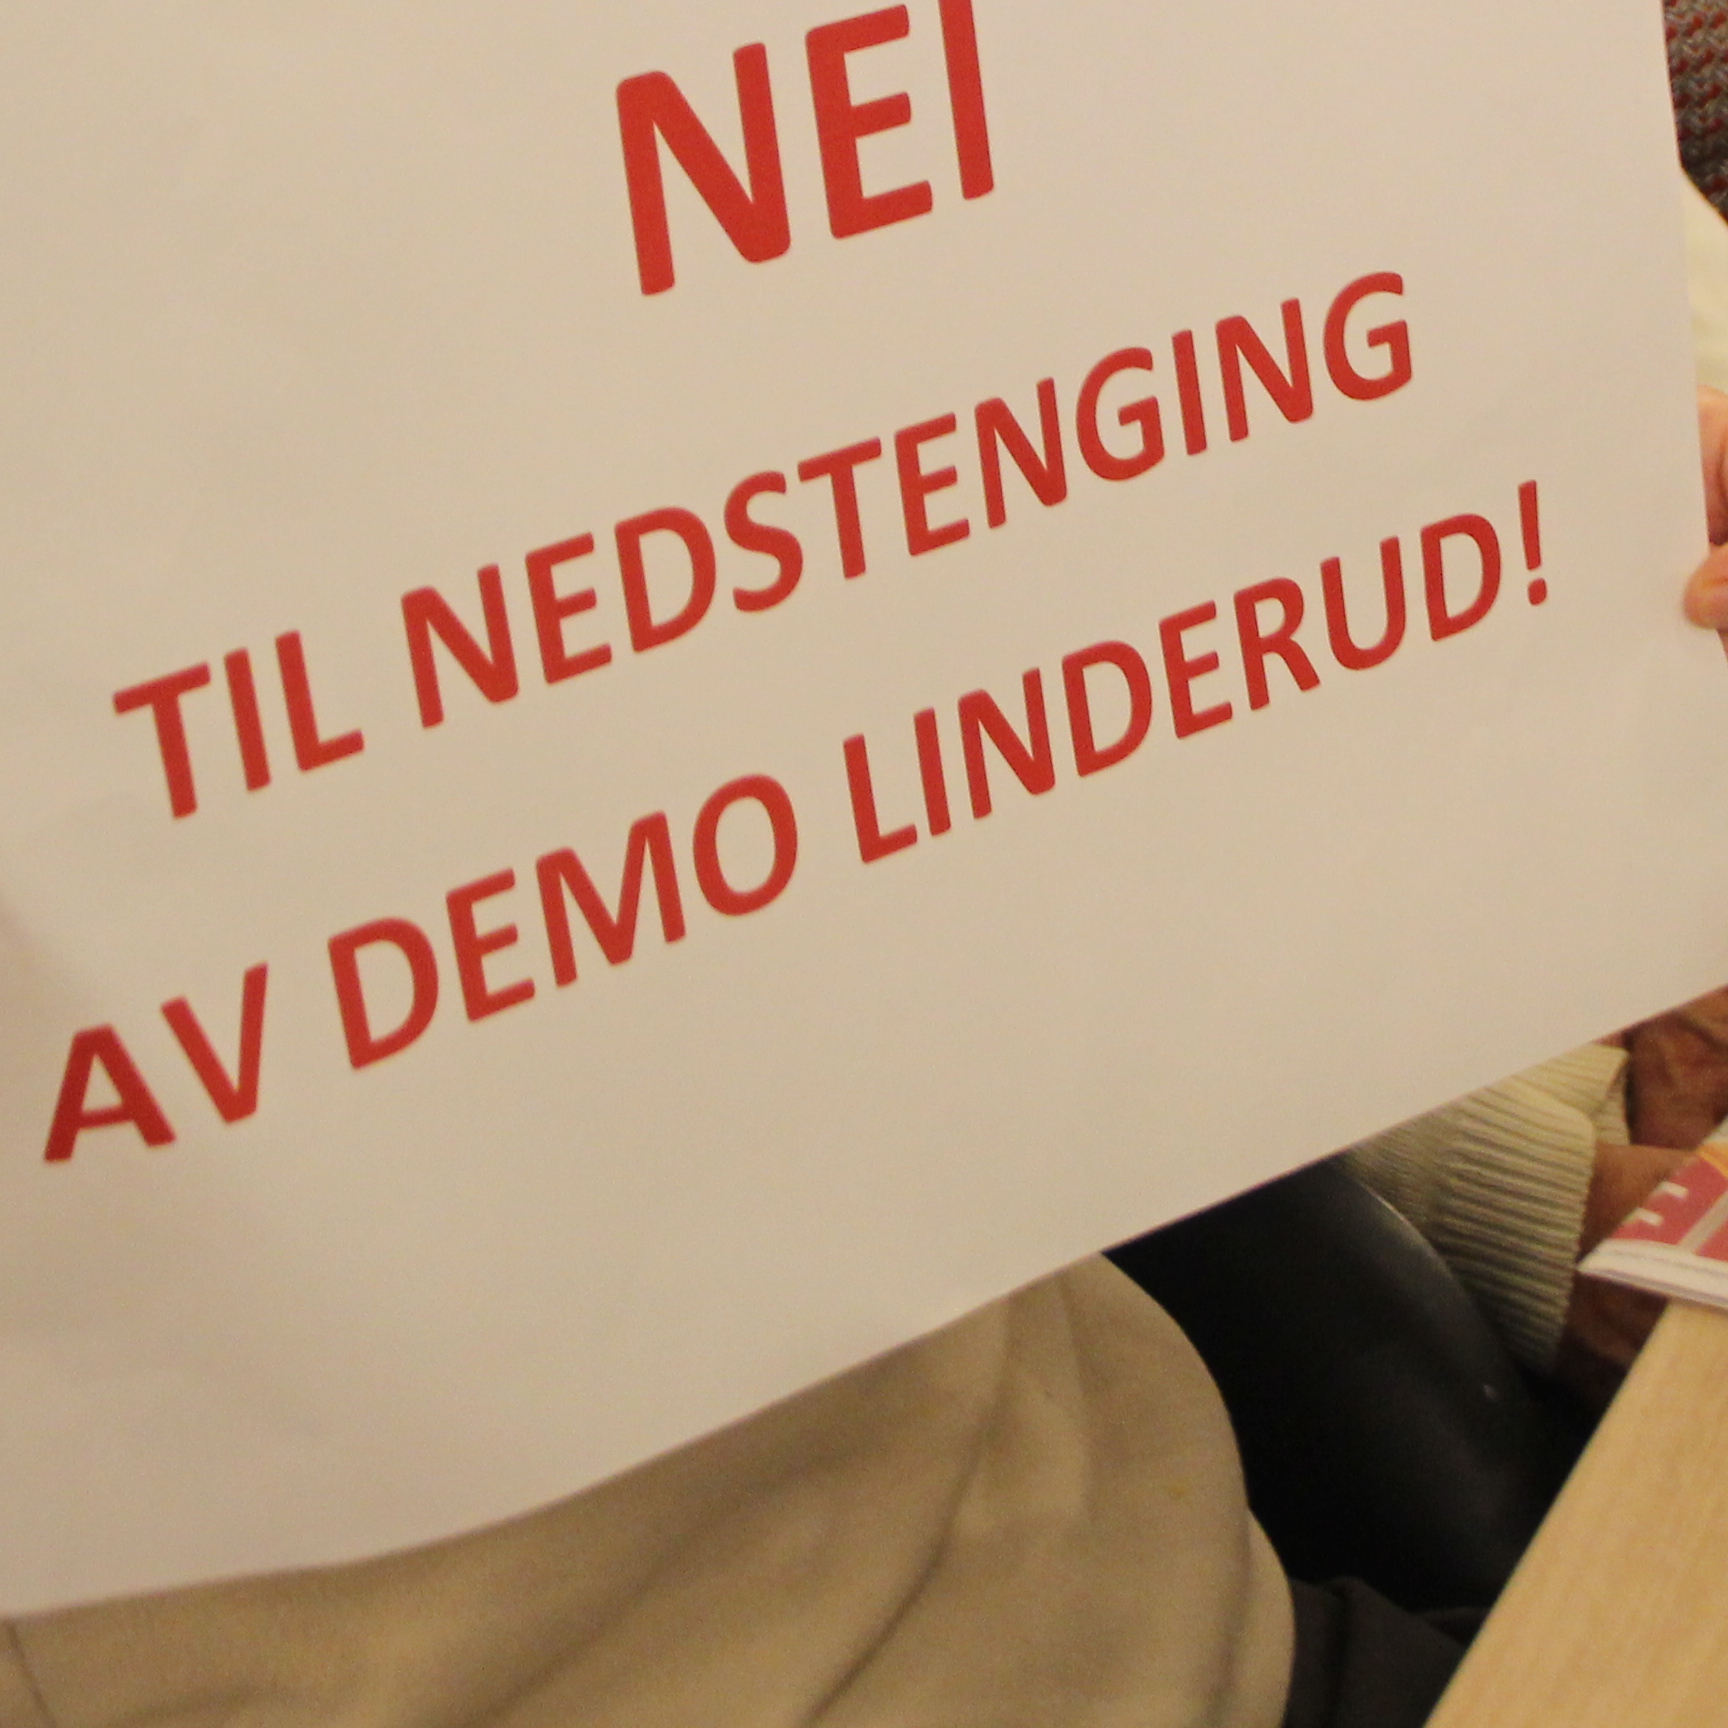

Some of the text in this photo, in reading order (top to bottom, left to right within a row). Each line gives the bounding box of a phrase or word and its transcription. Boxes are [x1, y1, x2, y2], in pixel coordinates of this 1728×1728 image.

[44, 478, 1550, 1164] AV DEMO LINDERUD!
[113, 270, 1415, 821] TIL NEDSTENGING
